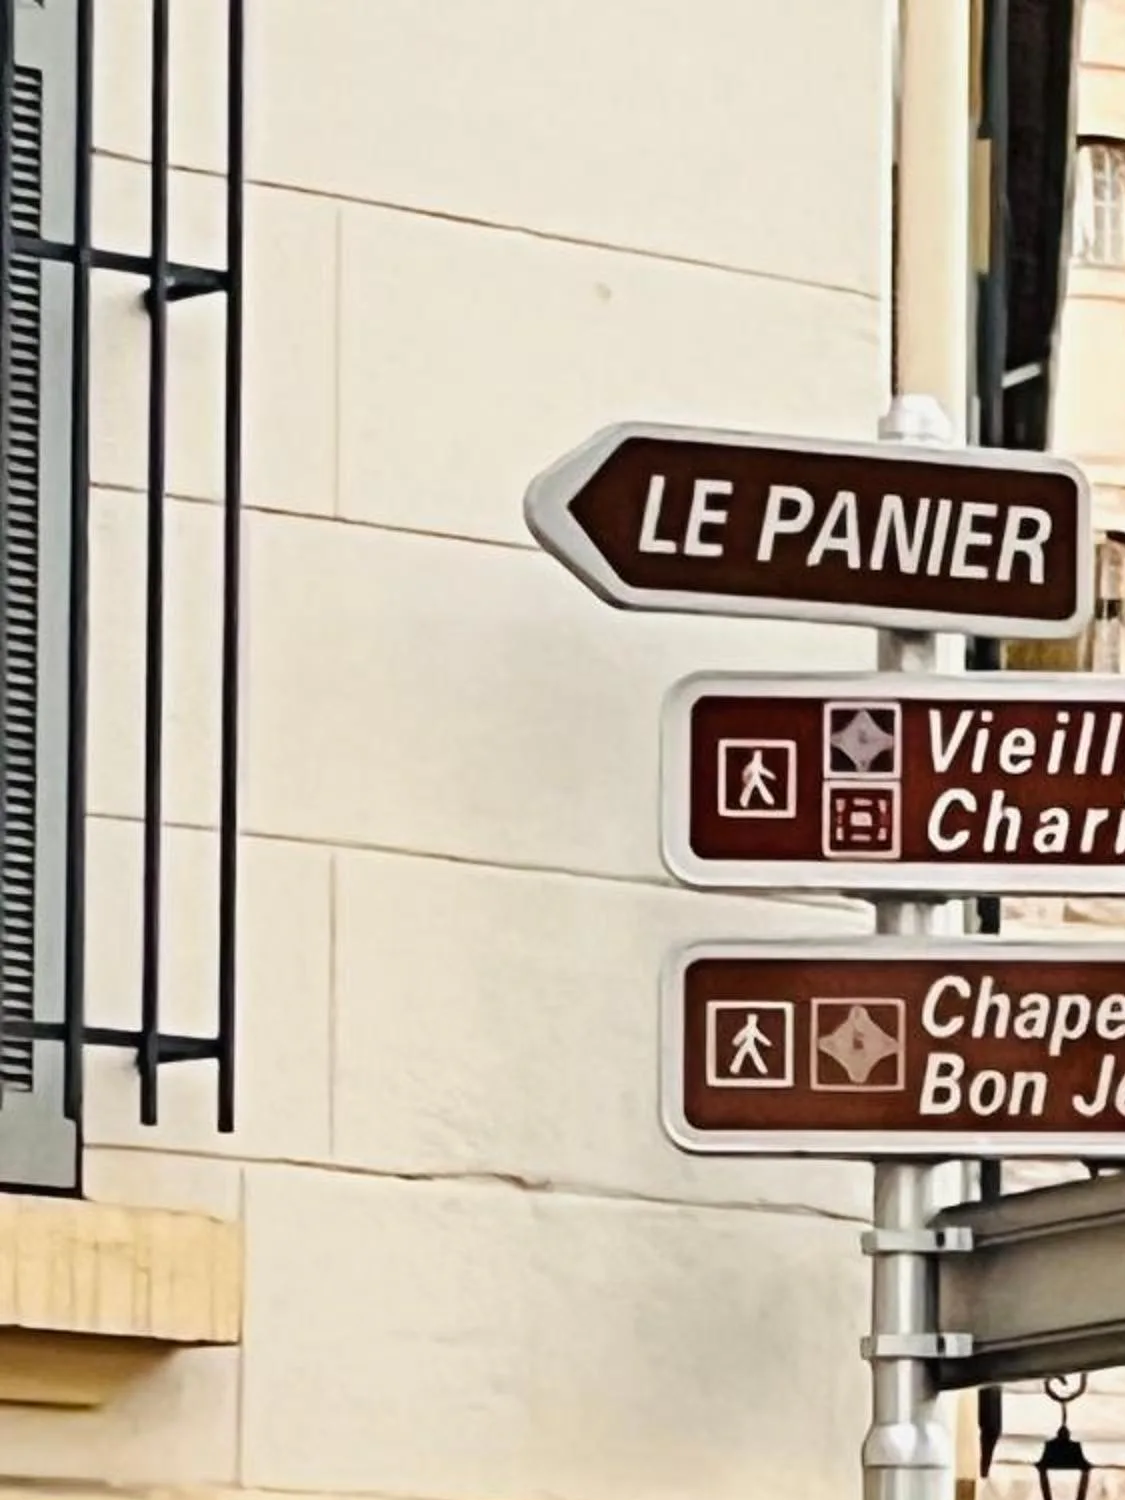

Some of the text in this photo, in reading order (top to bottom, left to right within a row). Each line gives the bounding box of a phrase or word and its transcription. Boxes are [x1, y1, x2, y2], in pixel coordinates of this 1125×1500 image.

[638, 475, 1053, 584] LE PANIER
[918, 1053, 1047, 1117] Bon
